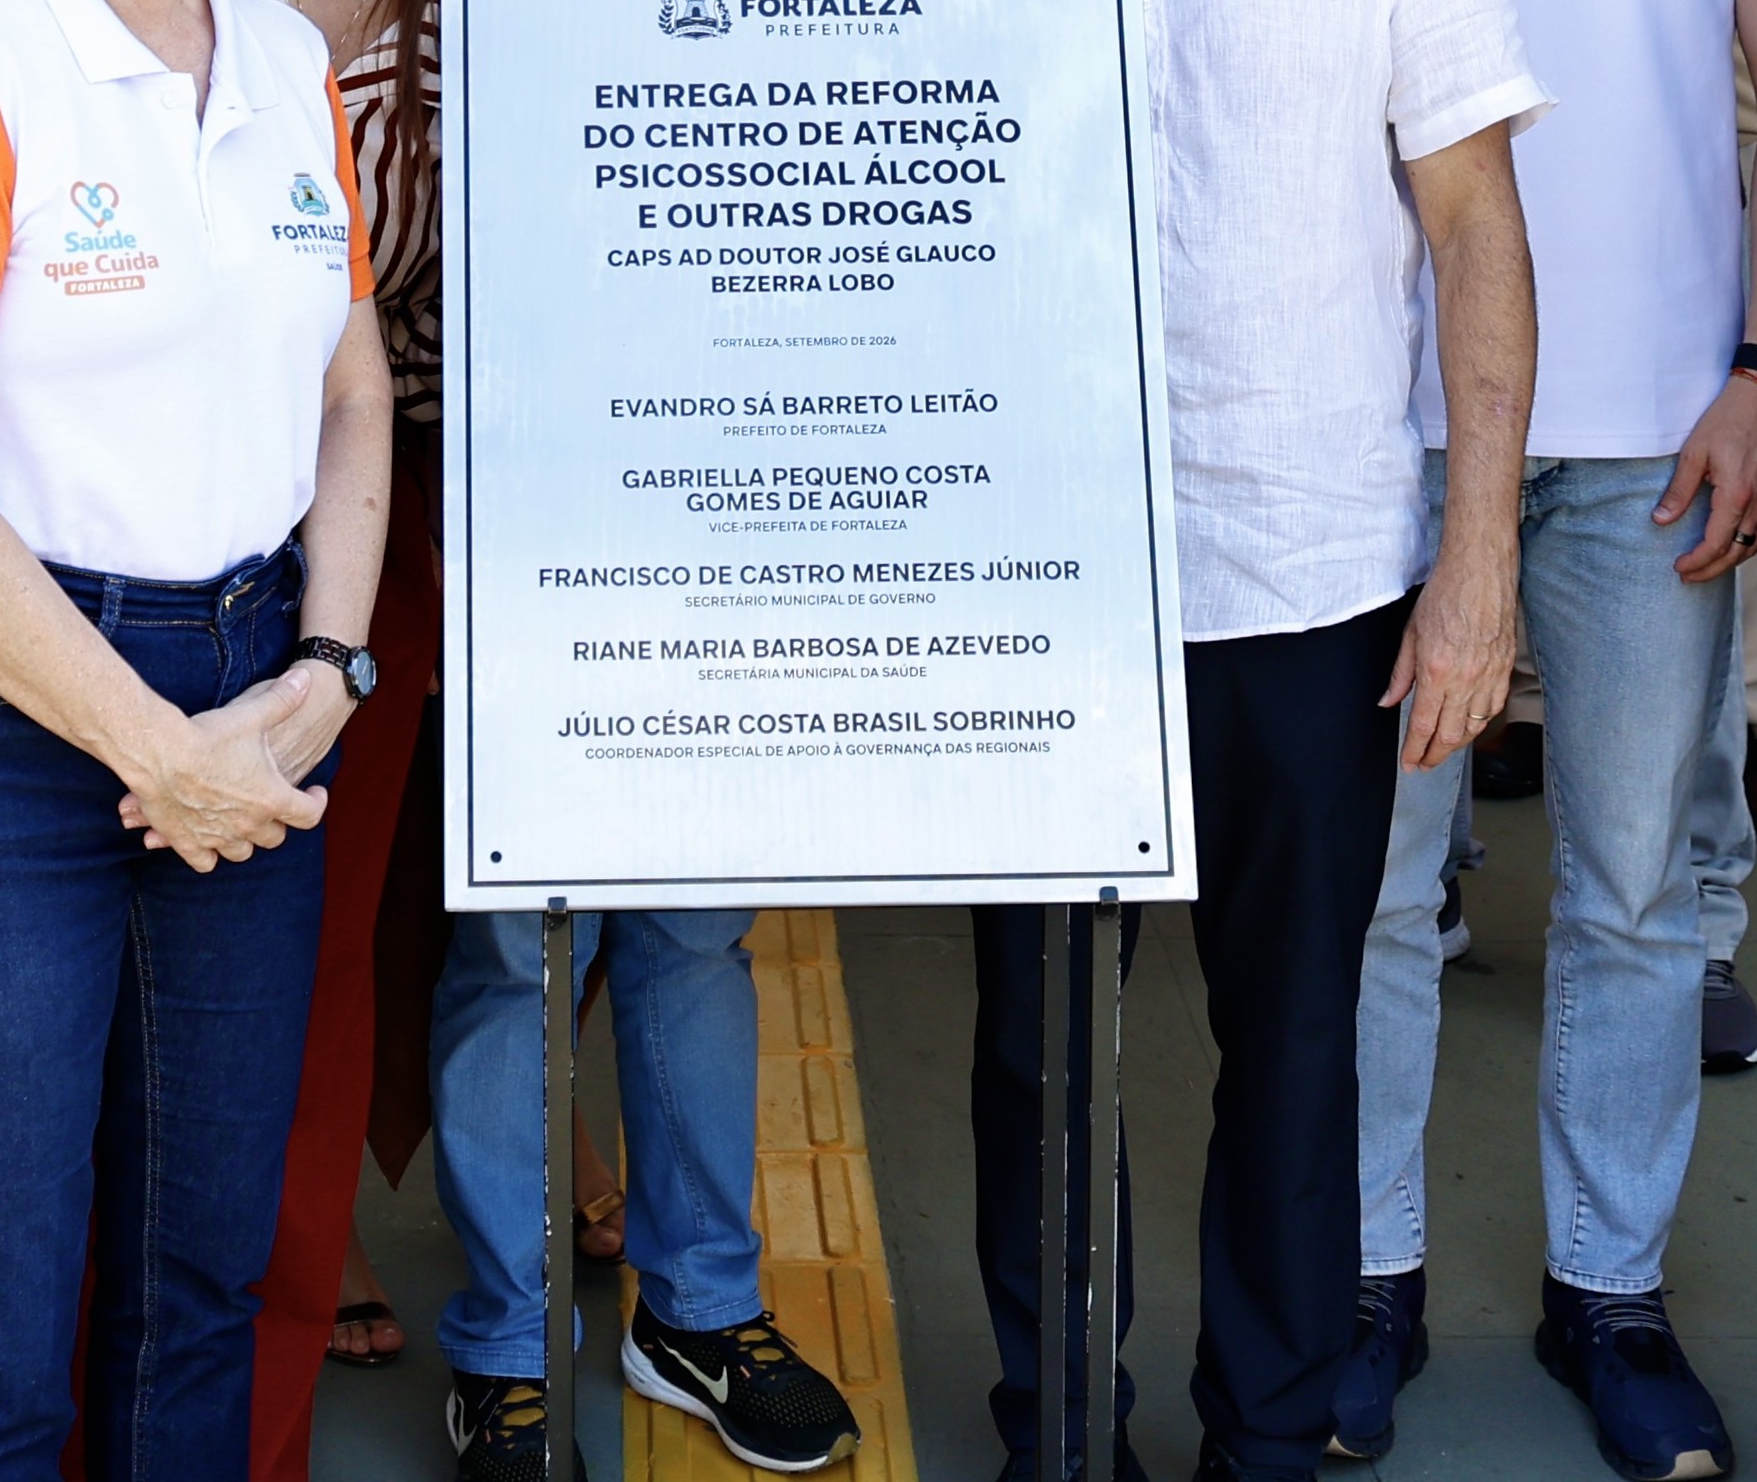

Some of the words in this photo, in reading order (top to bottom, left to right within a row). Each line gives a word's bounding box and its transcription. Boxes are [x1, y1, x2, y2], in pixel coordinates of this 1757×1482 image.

[765, 23, 900, 37] PREFEITURA
[595, 83, 758, 108] ENTREGA
[768, 82, 816, 106] DA
[827, 80, 1000, 105] REFORMA
[584, 124, 634, 148] DO
[644, 122, 789, 147] CENTRO
[798, 122, 844, 146] DE
[854, 111, 1021, 150] ATENÇÃO
[595, 161, 855, 188] PSICOSSOCIAL
[864, 153, 1005, 185] ÁLCOOL
[639, 205, 656, 228] E
[667, 202, 811, 228] OUTRAS
[822, 200, 972, 226] DROGAS
[64, 229, 137, 253] Saúde
[272, 224, 348, 243] FORTALEZ
[608, 249, 671, 267] CAPS
[678, 248, 712, 266] AD
[719, 247, 821, 266] DOUTOR
[829, 241, 889, 264] JOSÉ
[896, 245, 996, 263] GLAUCO
[43, 259, 90, 282] que
[95, 251, 160, 274] Cuida
[70, 279, 140, 293] FORTALEZA
[711, 275, 822, 293] BEZERRA
[829, 274, 894, 291] LOBO
[713, 338, 783, 348] FORTALEZA,
[785, 337, 848, 347] SETEMBRO
[851, 337, 866, 346] DE
[869, 336, 897, 345] 2026
[610, 397, 736, 418] EVANDRO
[743, 391, 776, 416] SÁ
[783, 395, 903, 415] BARRETO
[910, 388, 998, 414] LEITÃO
[723, 425, 787, 436] PREFEITO
[791, 425, 808, 436] DE
[811, 424, 887, 435] FORTALEZA
[622, 468, 765, 489] GABRIELLA
[772, 466, 898, 488] PEQUENO
[905, 465, 991, 485] COSTA
[686, 492, 781, 513] GOMES
[789, 491, 822, 512] DE
[829, 490, 928, 510] AGUIAR
[708, 521, 806, 533] VICE-PREFEITA
[810, 521, 828, 532] DE
[831, 520, 908, 531] FORTALEZA
[539, 567, 690, 588] FRANCISCO
[699, 566, 732, 585] DE
[739, 564, 844, 585] CASTRO
[853, 562, 975, 584] MENEZES
[981, 555, 1081, 581] JÚNIOR
[685, 592, 768, 607] SECRETÁRIO
[771, 594, 845, 606] MUNICIPAL
[848, 594, 866, 605] DE
[869, 593, 936, 605] GOVERNO
[573, 640, 652, 661] RIANE
[660, 639, 745, 660] MARIA
[753, 637, 879, 658] BARBOSA
[887, 636, 920, 656] DE
[927, 635, 1051, 656] AZEVEDO
[698, 666, 780, 680] SECRETÁRIA
[783, 667, 857, 679] MUNICIPAL
[860, 667, 879, 678] DA
[882, 663, 927, 678] SAÚDE
[558, 711, 635, 737] JÚLIO
[643, 710, 730, 736] CÉSAR
[738, 713, 825, 734] COSTA
[834, 712, 927, 733] BRASIL
[933, 710, 1076, 731] SOBRINHO
[585, 747, 694, 760] COORDENADOR
[697, 746, 762, 758] ESPECIAL
[765, 746, 783, 757] DE
[786, 745, 831, 757] APOIO
[833, 741, 844, 756] À
[846, 743, 942, 758] GOVERNANÇA
[945, 743, 972, 754] DAS
[975, 741, 1050, 754] REGIONAIS
